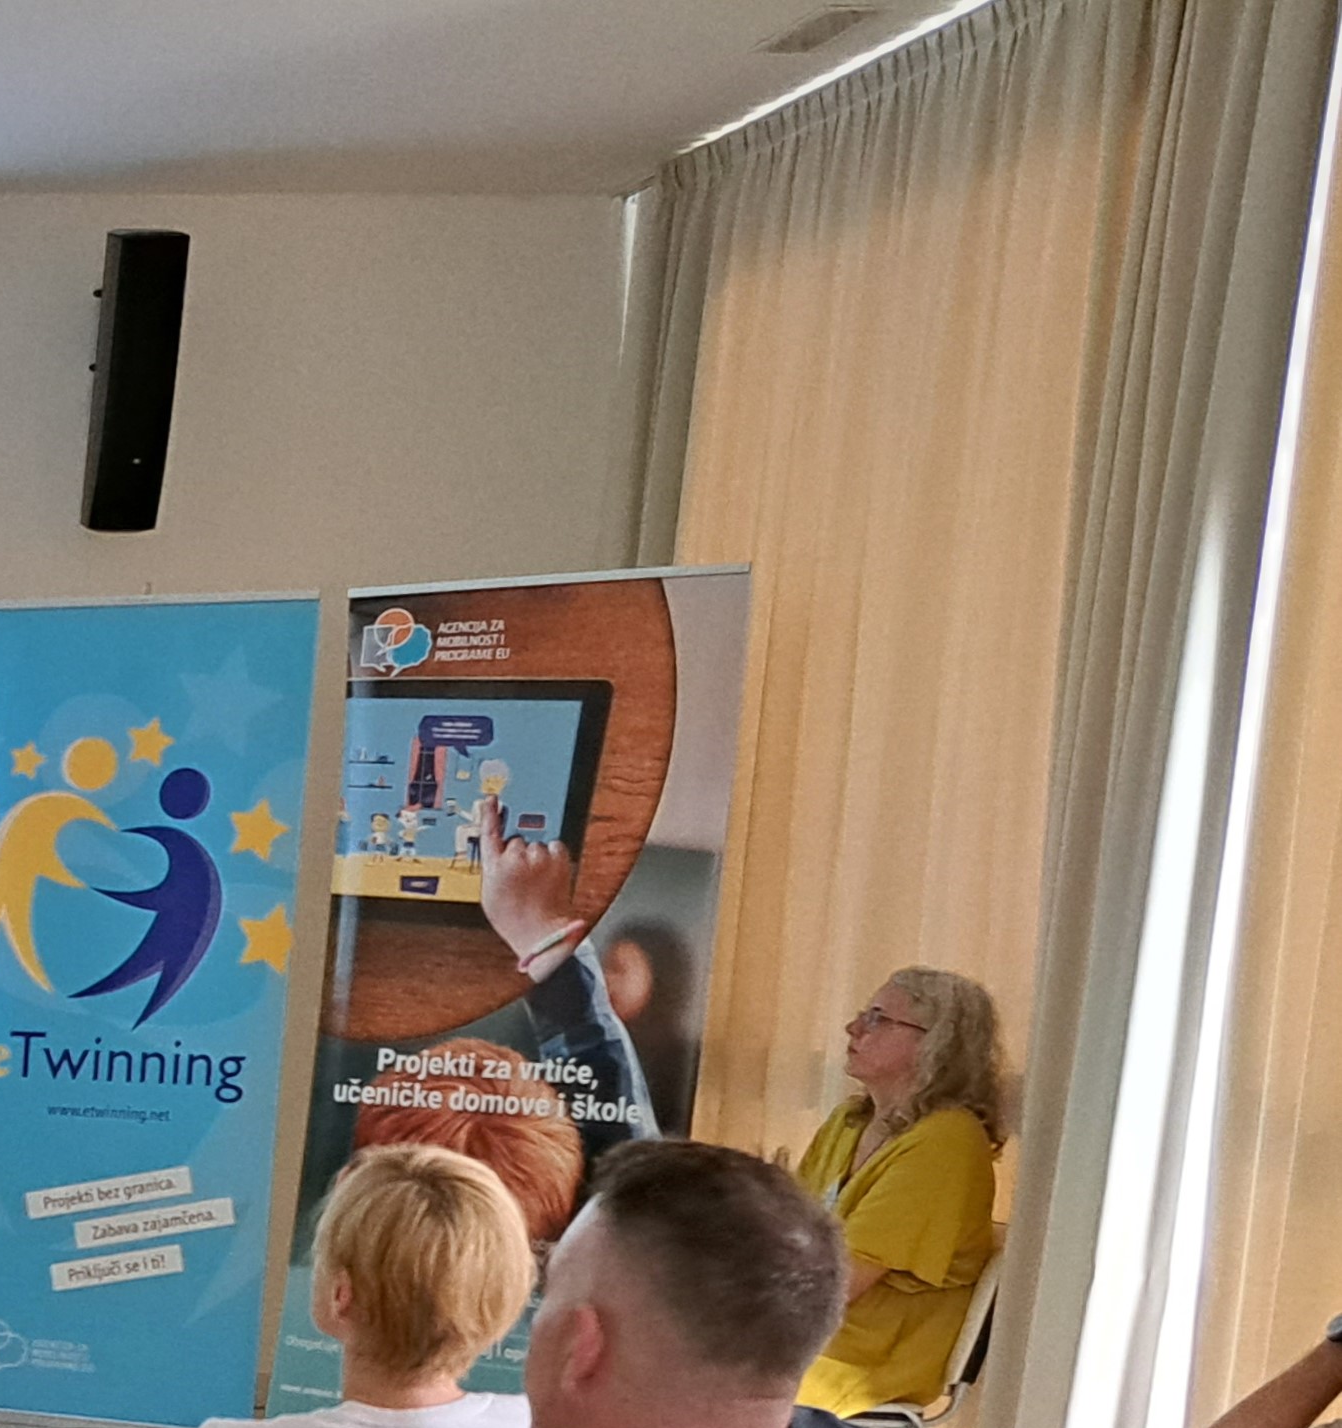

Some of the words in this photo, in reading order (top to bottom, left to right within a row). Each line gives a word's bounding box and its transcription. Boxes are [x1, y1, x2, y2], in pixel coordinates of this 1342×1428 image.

[437, 621, 488, 633] AGENCIJA
[490, 620, 505, 631] ZA
[436, 634, 498, 647] MOBILNOST
[434, 648, 494, 661] PROGRAME
[496, 648, 510, 659] EU
[377, 1047, 475, 1081] Projekti
[481, 1057, 512, 1080] za
[518, 1057, 599, 1089] vrtiće,
[333, 1080, 442, 1109] učeničke
[449, 1086, 550, 1116] domove
[557, 1093, 566, 1117] i
[571, 1094, 641, 1124] škole
[47, 1105, 171, 1123] www.etwinning.net
[43, 1193, 93, 1211] Projekti
[98, 1186, 120, 1200] bez
[91, 1224, 139, 1241] Zabava
[125, 1261, 139, 1273] se
